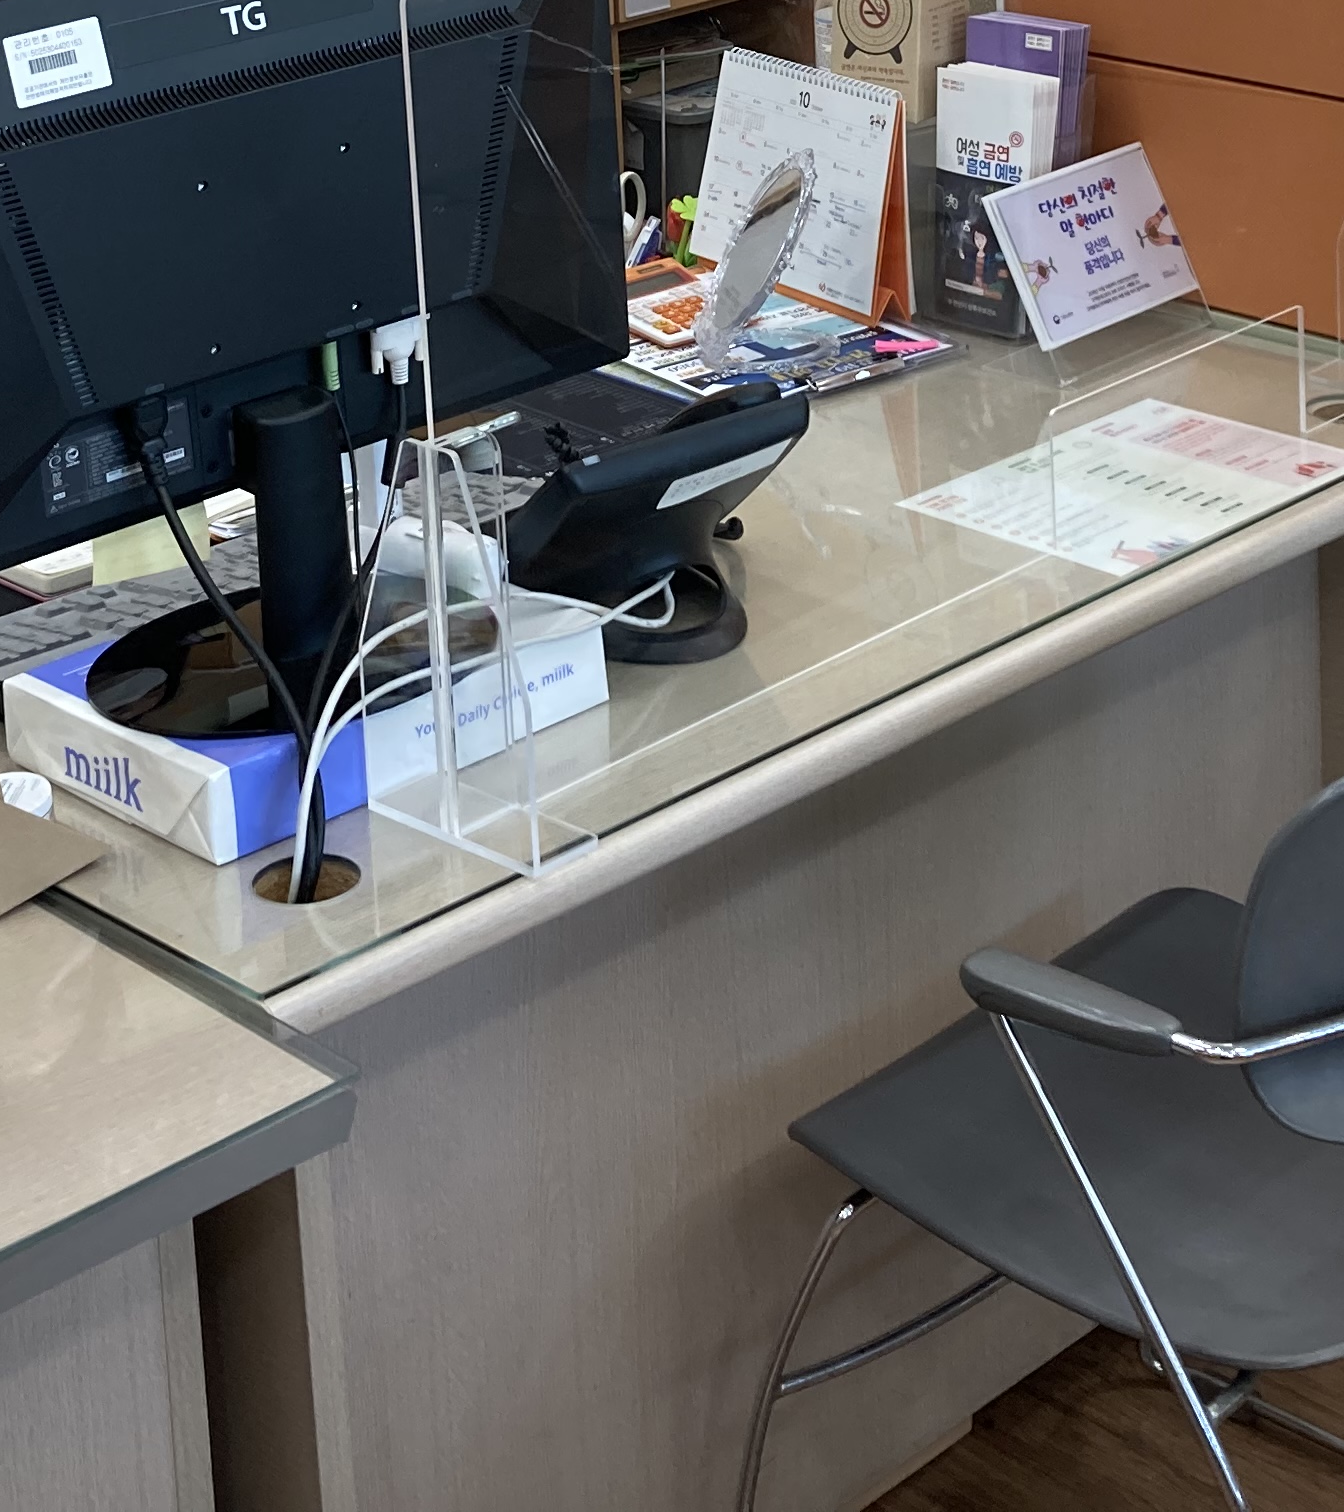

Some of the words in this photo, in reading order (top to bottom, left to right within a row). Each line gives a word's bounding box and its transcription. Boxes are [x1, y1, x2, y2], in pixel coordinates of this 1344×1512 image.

[220, 1, 267, 35] TG
[799, 91, 811, 108] 10
[956, 137, 979, 157] 여성
[984, 142, 1009, 163] 금연
[967, 158, 991, 178] 흡연
[995, 163, 1023, 183] 예방
[1038, 194, 1078, 218] 당신의
[1078, 177, 1118, 203] 친절한
[1084, 235, 1111, 255] 당신의
[1084, 248, 1125, 275] 품격입니다
[457, 703, 491, 728] Daily
[542, 663, 575, 687] miilk
[64, 745, 144, 812] miilk
